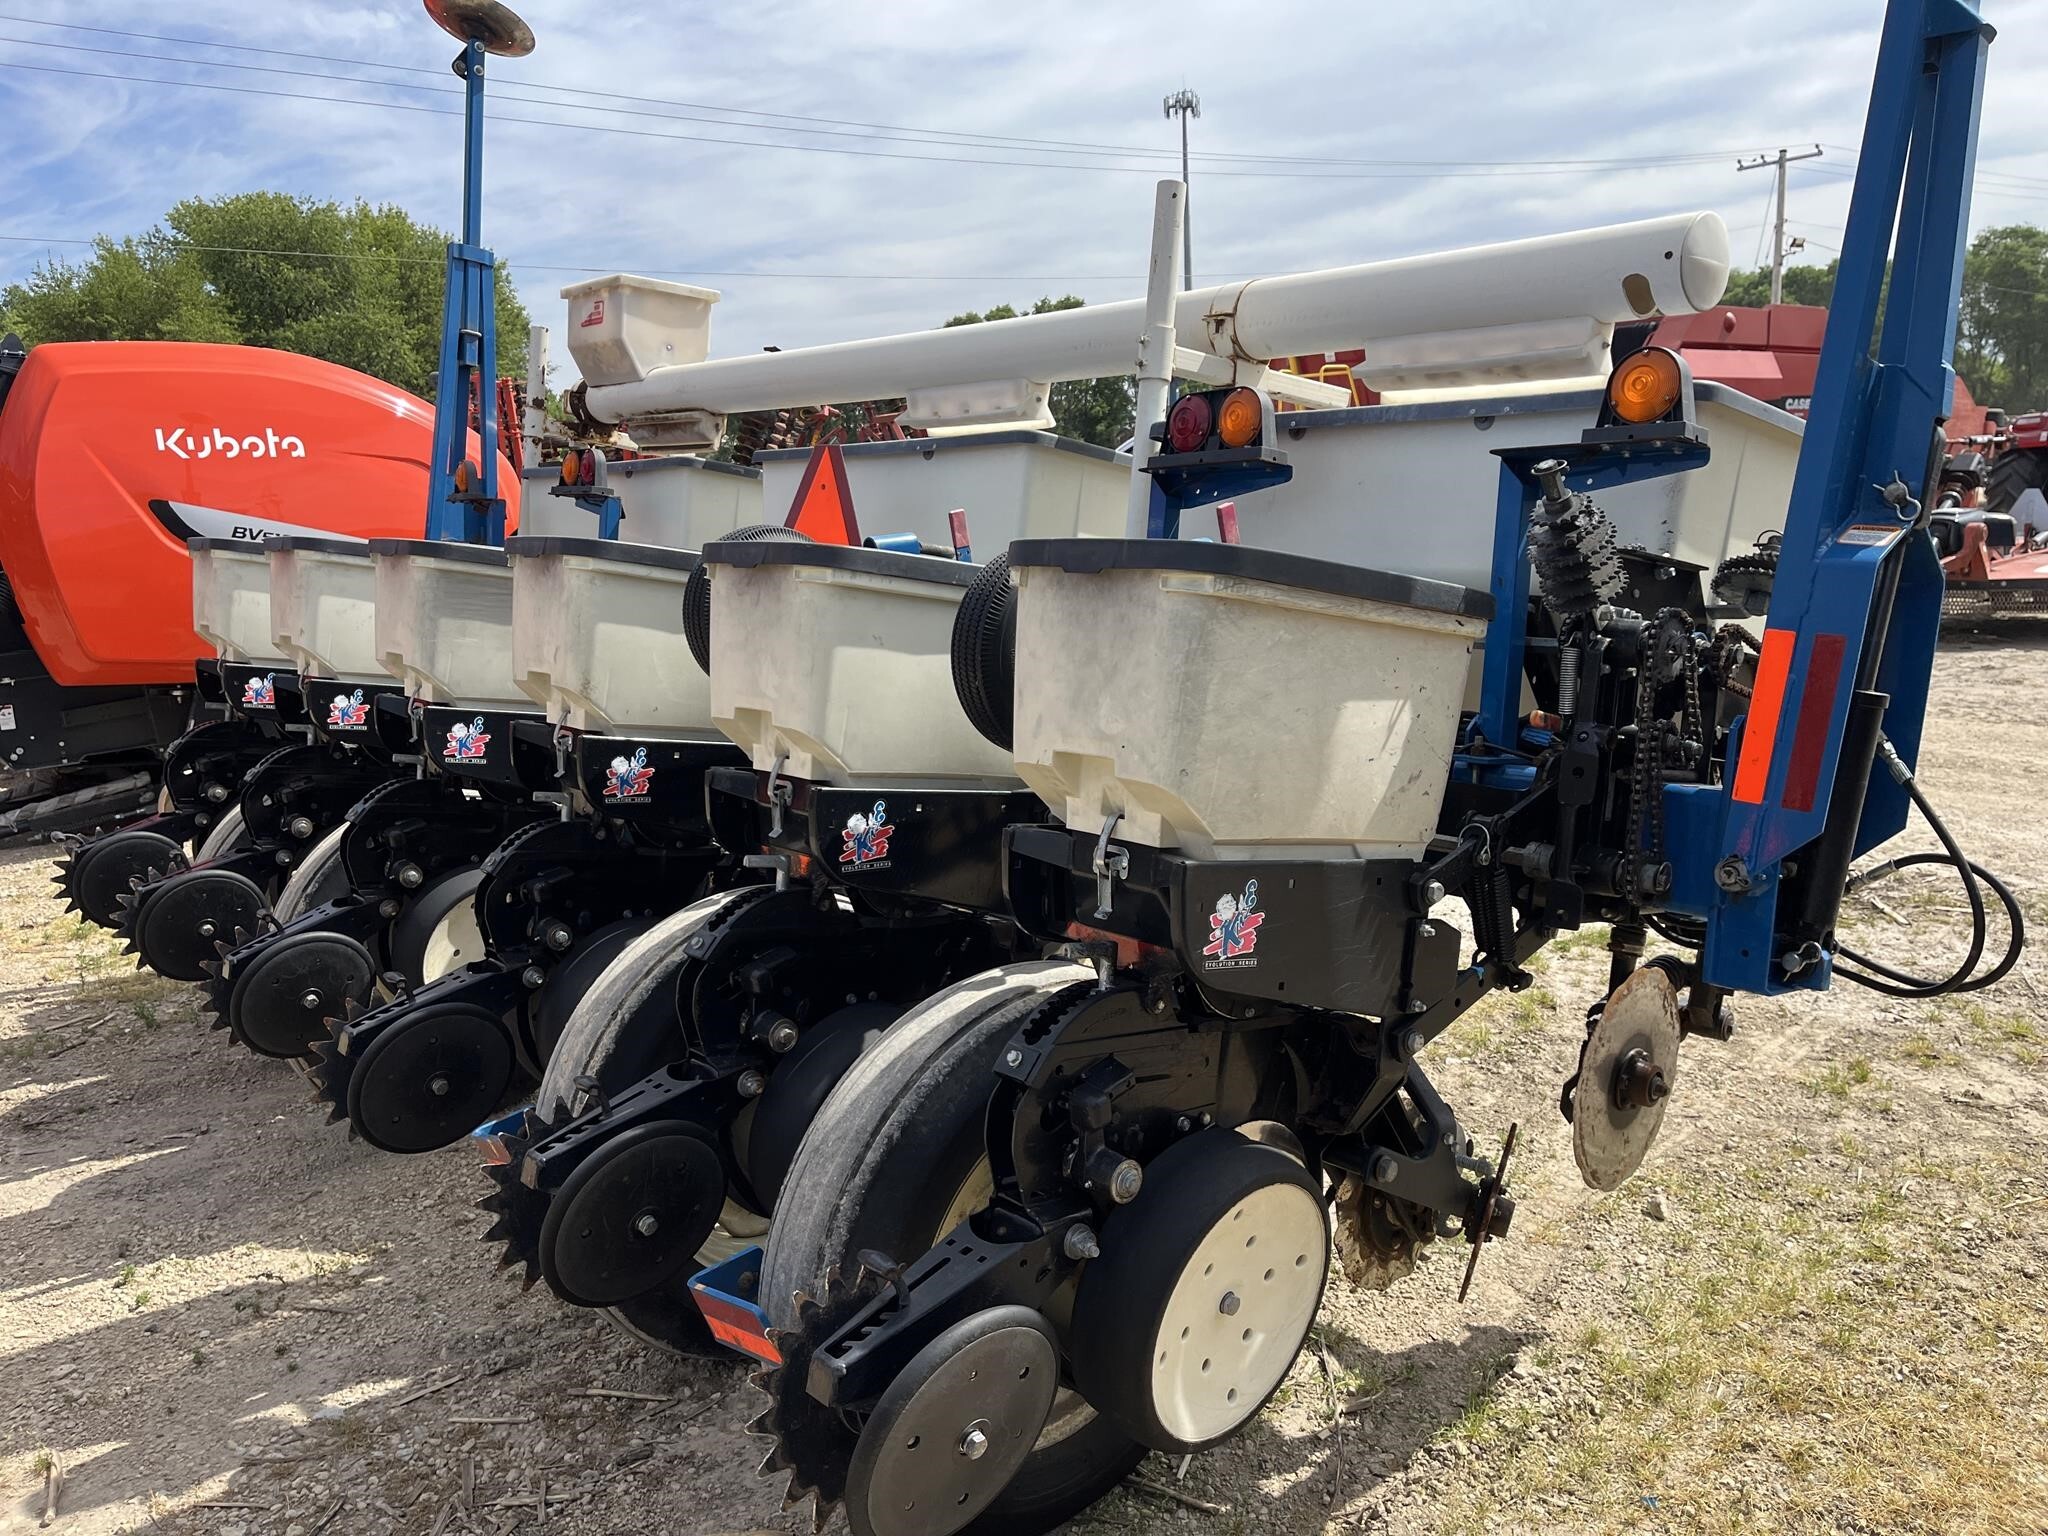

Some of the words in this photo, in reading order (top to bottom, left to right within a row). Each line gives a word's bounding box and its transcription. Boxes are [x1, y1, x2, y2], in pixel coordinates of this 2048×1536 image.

[155, 427, 305, 459] Kubota
[1204, 961, 1235, 969] EVOLUTION
[1238, 959, 1258, 967] SERIES
